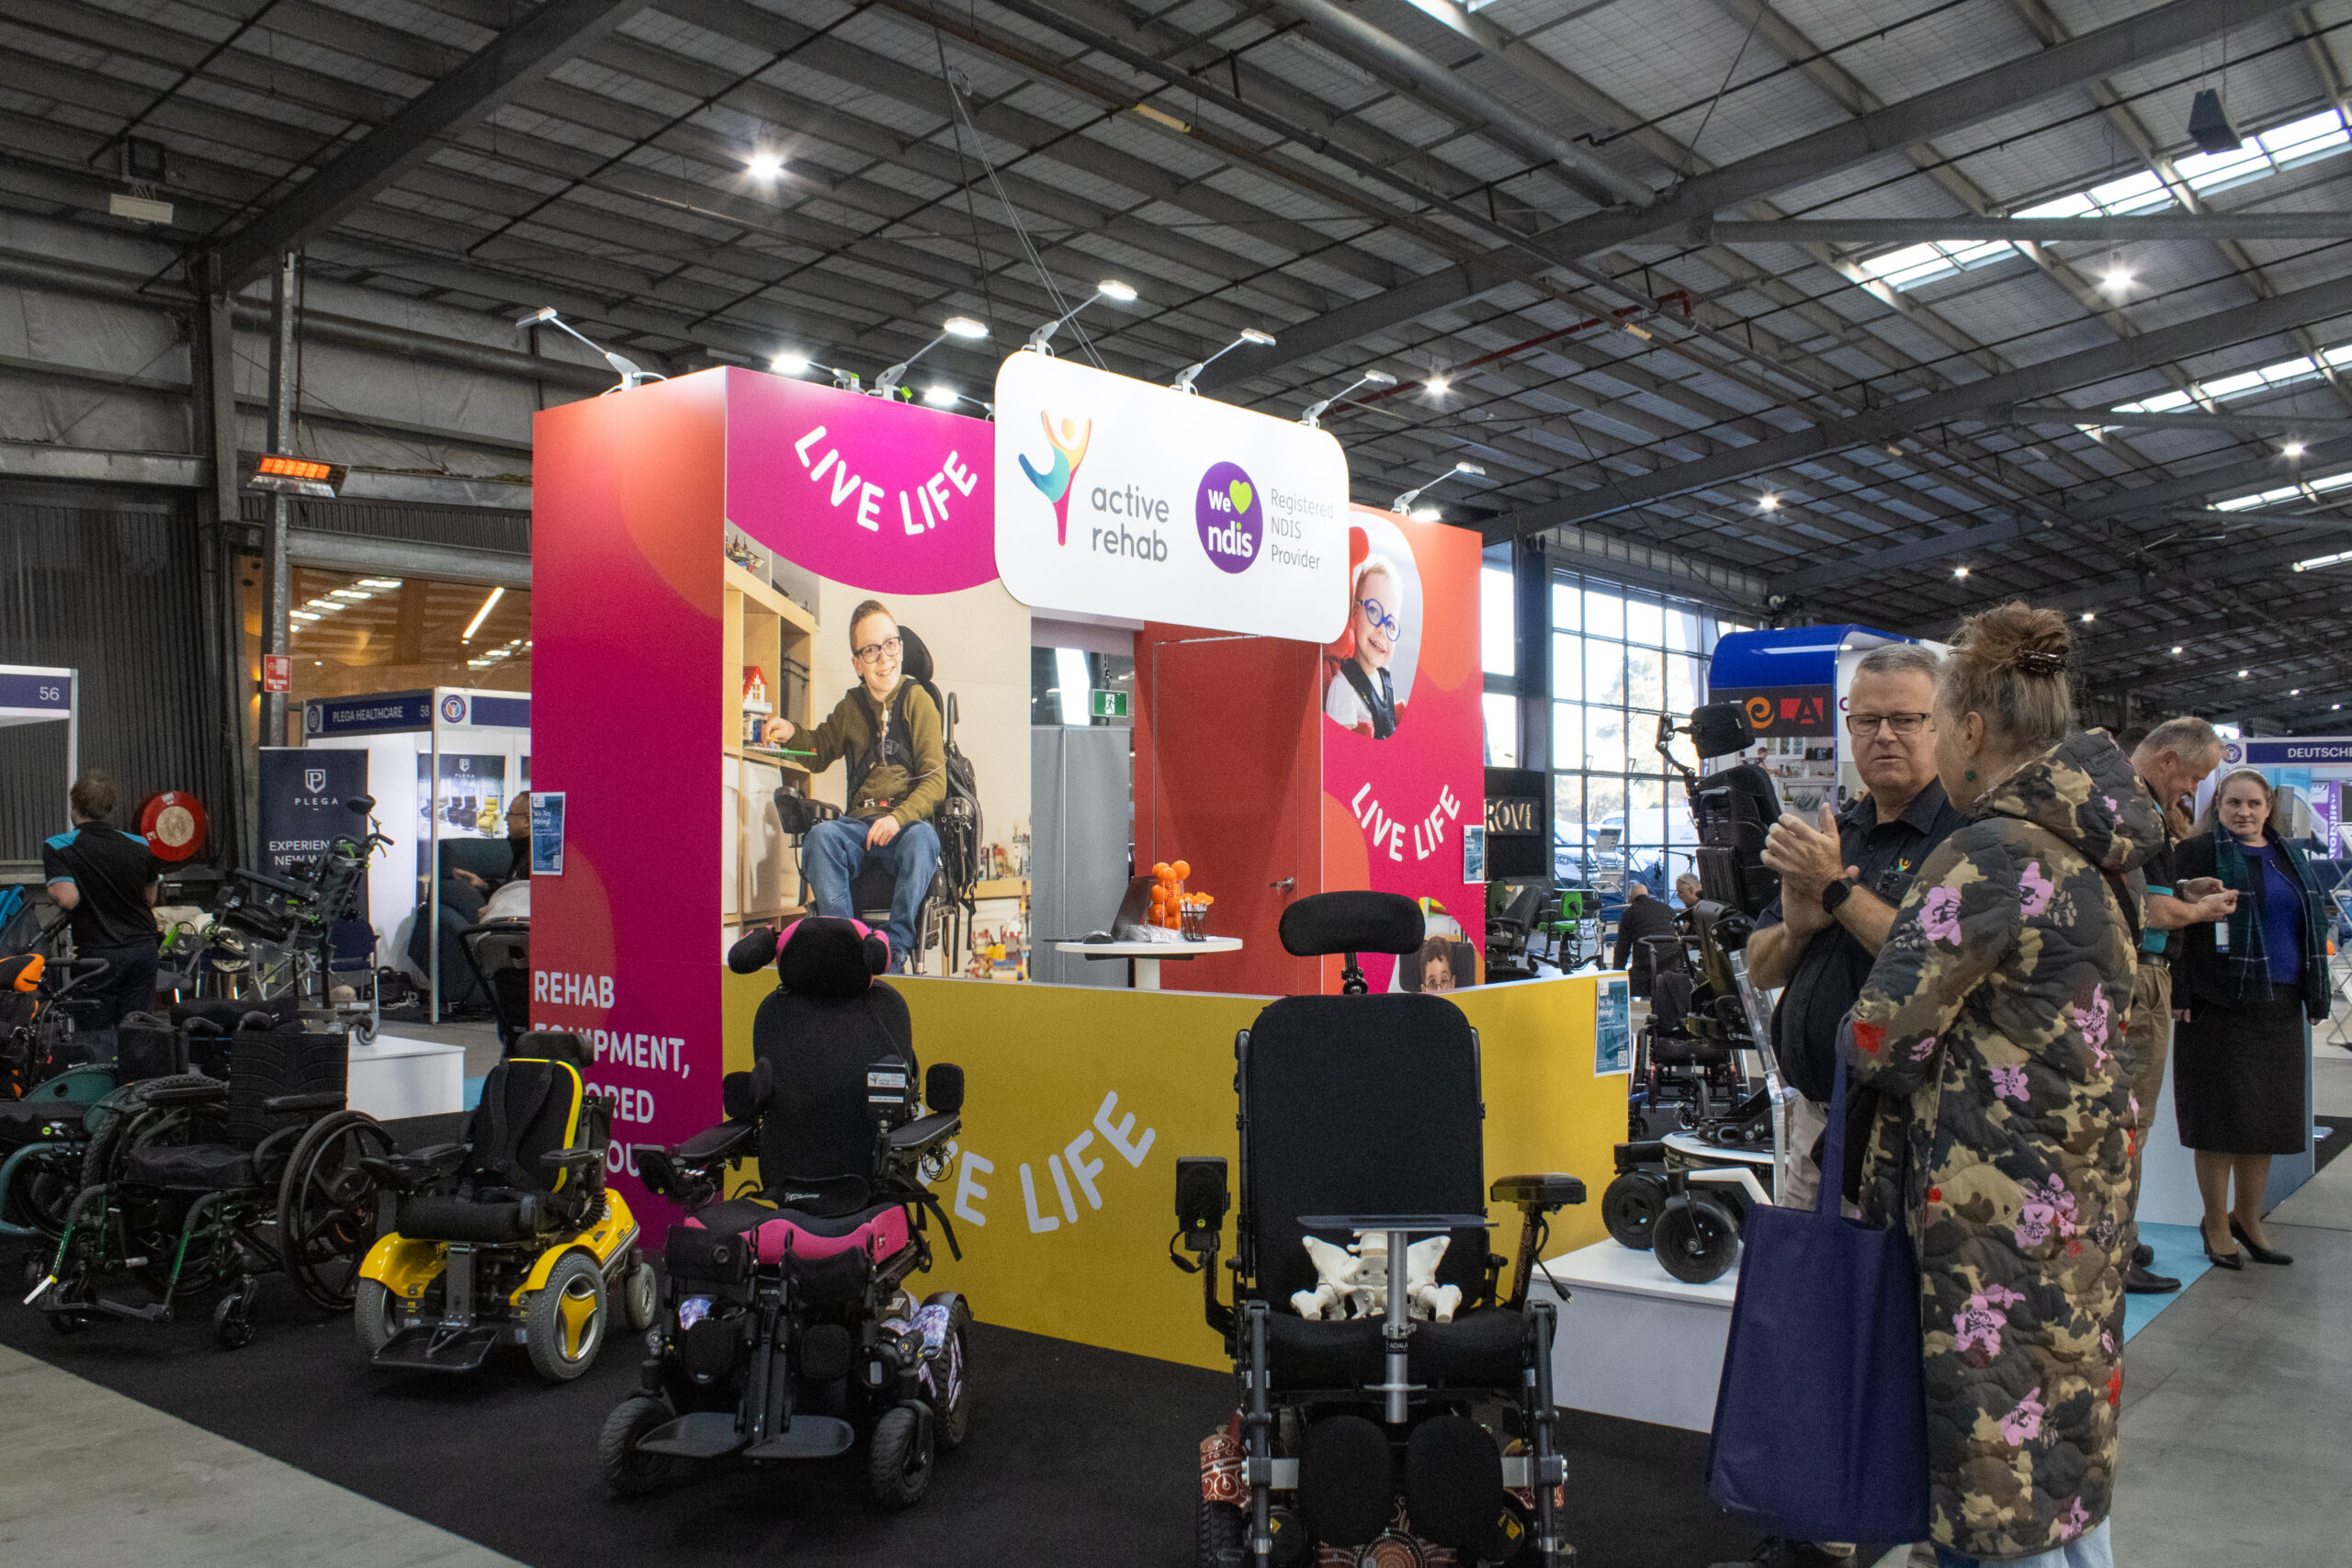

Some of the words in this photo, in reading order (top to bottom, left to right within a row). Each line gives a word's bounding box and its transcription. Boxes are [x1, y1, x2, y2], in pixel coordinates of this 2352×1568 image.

[794, 425, 885, 532] LIVE
[899, 449, 978, 536] LIFE
[1091, 483, 1170, 523] active
[1207, 489, 1232, 513] We
[1271, 488, 1334, 519] Registered
[1091, 524, 1169, 562] rehab
[1207, 520, 1253, 558] ndis
[1271, 516, 1302, 539] NDIS
[1271, 544, 1320, 570] Provider
[39, 686, 60, 701] 56
[332, 709, 356, 723] PLEGA
[356, 705, 403, 720] HEALTHCARE
[419, 705, 430, 717] 58
[294, 797, 339, 806] PLEGA
[1351, 782, 1406, 863] LIVE
[1413, 784, 1461, 862] LIFE
[269, 840, 330, 852] EXPERIEN
[534, 970, 615, 1009] REHAB
[535, 1022, 690, 1079] PMENT,
[1019, 1090, 1157, 1234] LIFE
